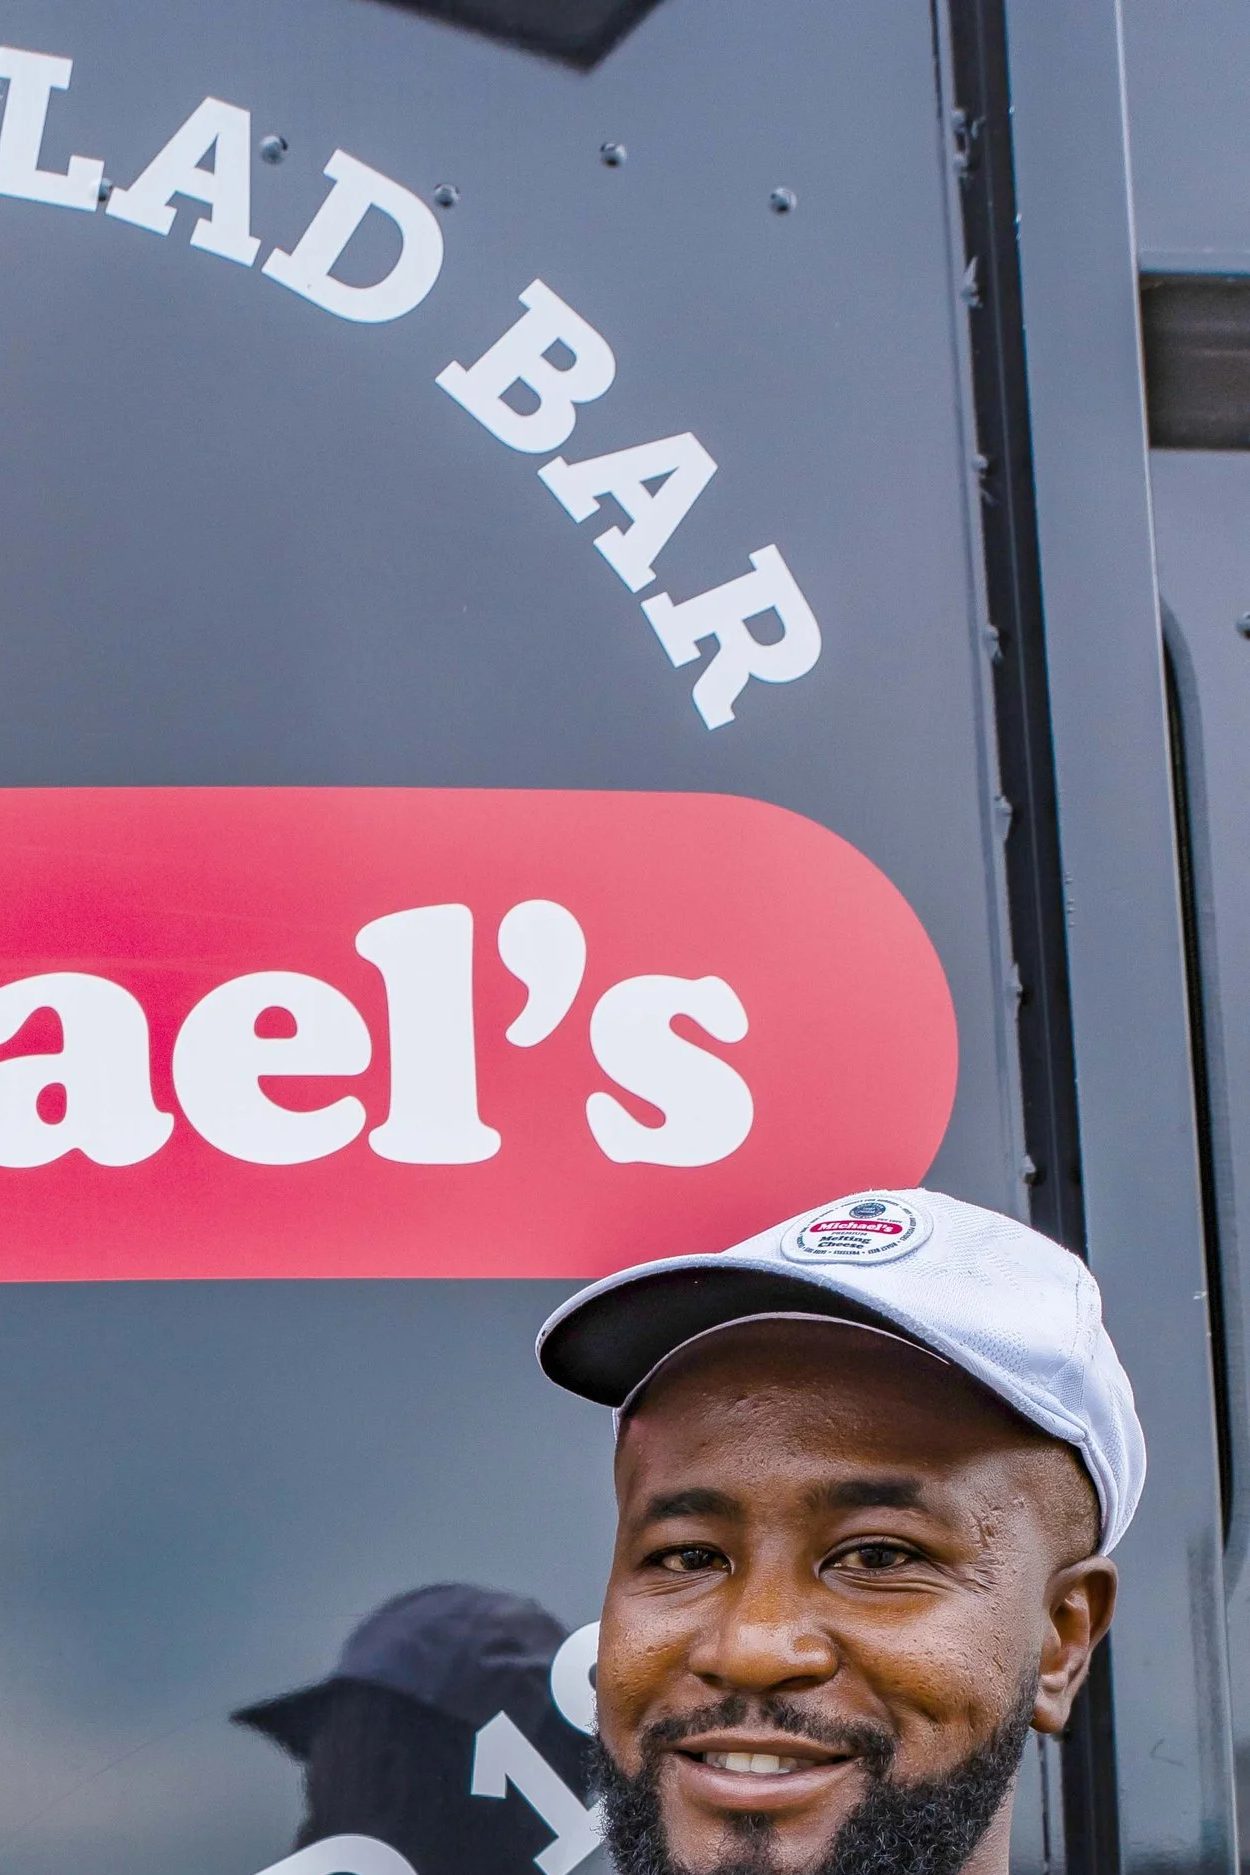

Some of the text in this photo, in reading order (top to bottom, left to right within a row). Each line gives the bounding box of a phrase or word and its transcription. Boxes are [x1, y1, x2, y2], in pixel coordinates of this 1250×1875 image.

[435, 278, 822, 730] BAR
[817, 1221, 894, 1233] Michael's
[817, 1241, 865, 1250] Cheese
[818, 1235, 872, 1245] Melting
